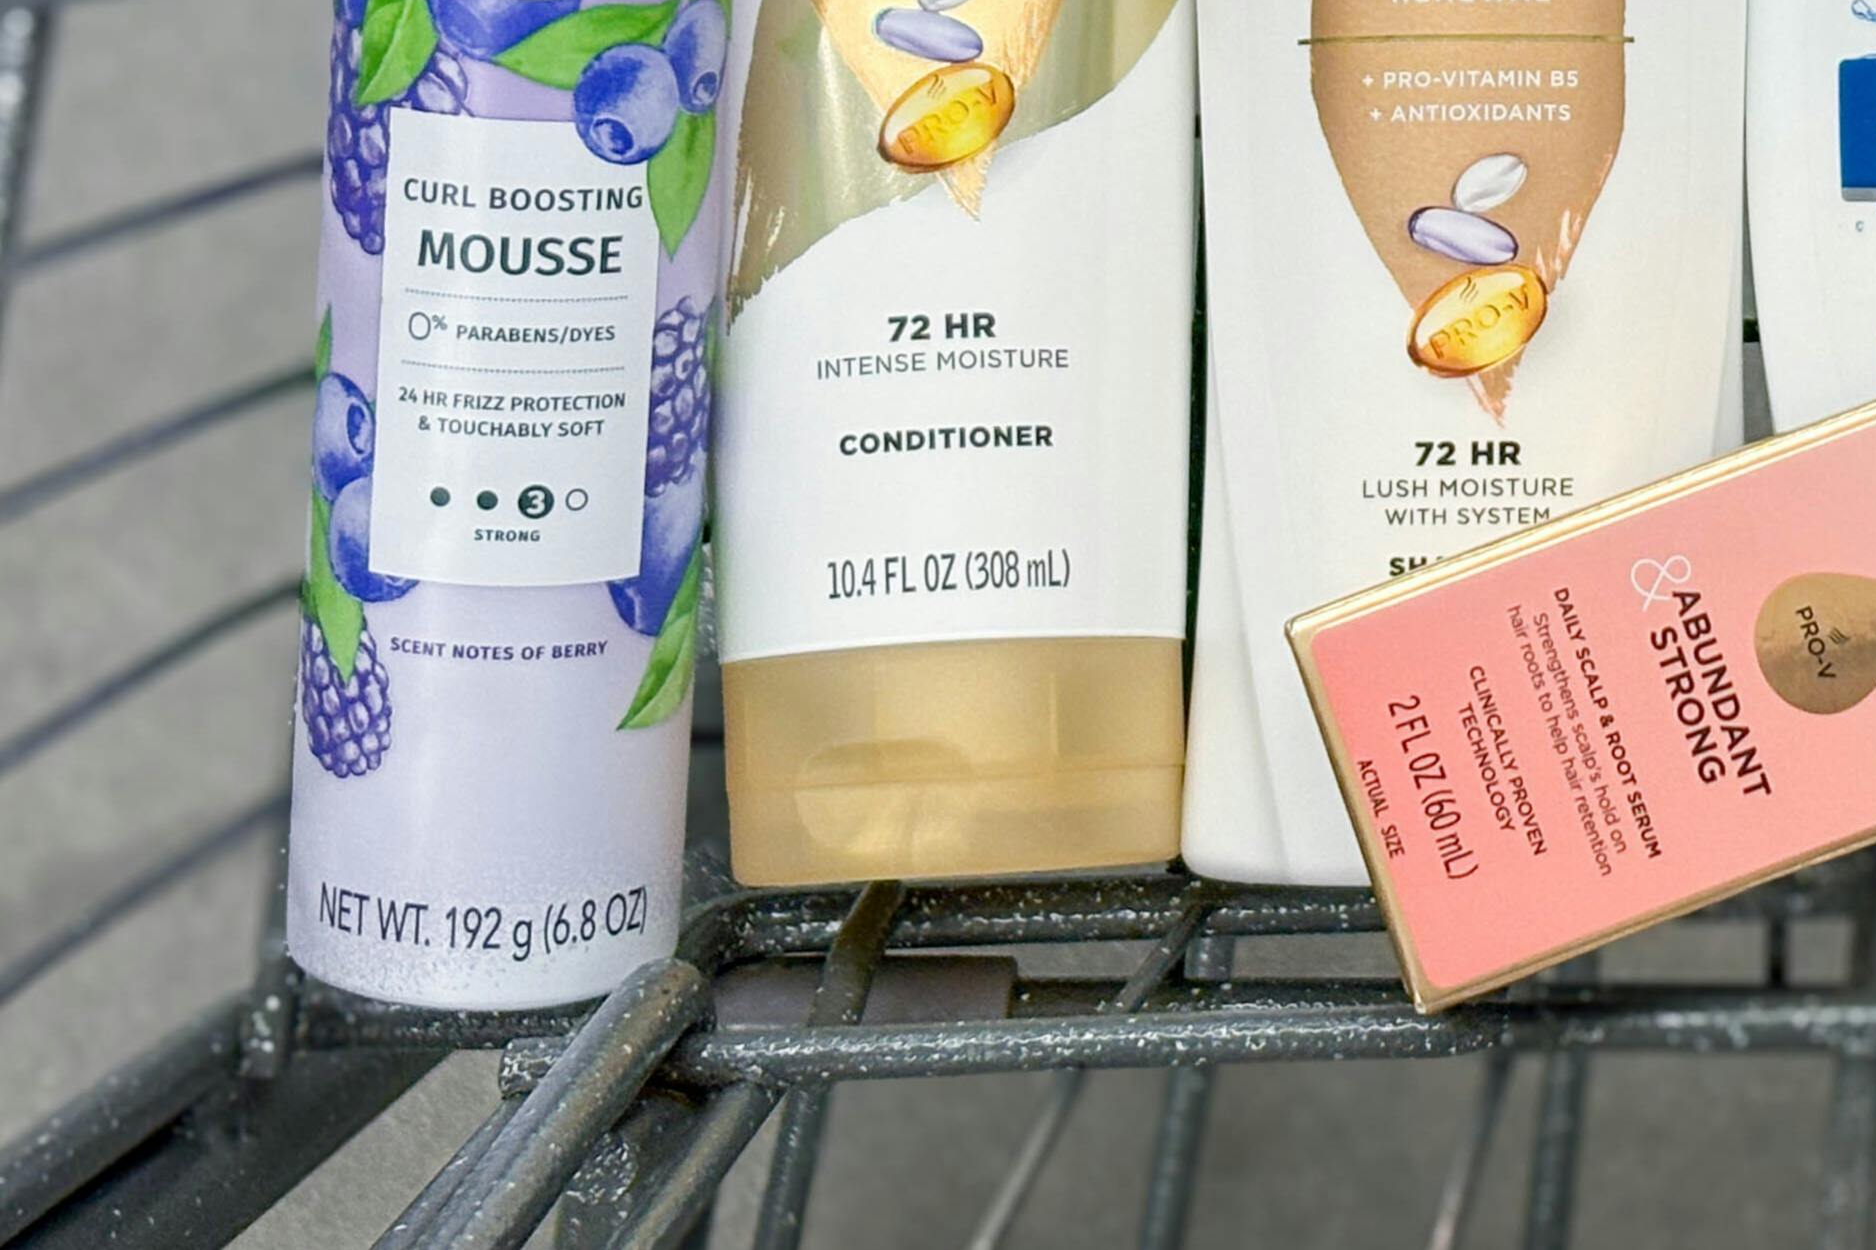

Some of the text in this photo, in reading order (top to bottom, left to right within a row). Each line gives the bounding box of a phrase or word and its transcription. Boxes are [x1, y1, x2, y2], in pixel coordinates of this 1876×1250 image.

[1383, 70, 1579, 88] PRO-VITAMIN B5
[1390, 104, 1571, 122] ANTIOXIDANTS
[403, 178, 644, 212] CURL BOOSTING
[417, 229, 624, 276] MOUSSE
[456, 324, 616, 344] PARABENS/DYES
[888, 312, 997, 342] 72 HR
[817, 348, 1069, 380] INTENSE MOISTURE
[398, 386, 626, 412] 24 HR FRIZZ PROTECTION
[418, 415, 605, 438] & TOUCHABLY SOFT
[839, 426, 1053, 456] CONDITIONER
[1415, 441, 1522, 467] 72 HR
[525, 488, 544, 515] 3
[1362, 477, 1574, 499] LUSH MOISTURE
[1385, 507, 1551, 525] WITH SYSTEM
[474, 529, 541, 542] STRONG
[827, 548, 1070, 599] 10.4 FL OZ (308 mL)
[390, 636, 608, 661] SCENT NOTES OF BERRY
[1795, 605, 1837, 680] PRO-V
[1631, 555, 1726, 784] & STRONG
[1673, 590, 1772, 798] ABUNDANT
[1534, 612, 1627, 854] Strengthens scalp's hold on
[1554, 587, 1663, 858] DAILY SCALP & ROOT SERUM
[1508, 604, 1612, 877] hair roots to help hair retention
[1458, 701, 1516, 832] TECHNOLOGY
[1469, 665, 1548, 857] CLINICALLY PROVEN
[1388, 695, 1480, 881] 2 FL OZ (60 mL)
[1357, 759, 1406, 859] ACTUAL SIZE
[320, 881, 648, 962] NET WT. 192 g (6.8 OZ)
